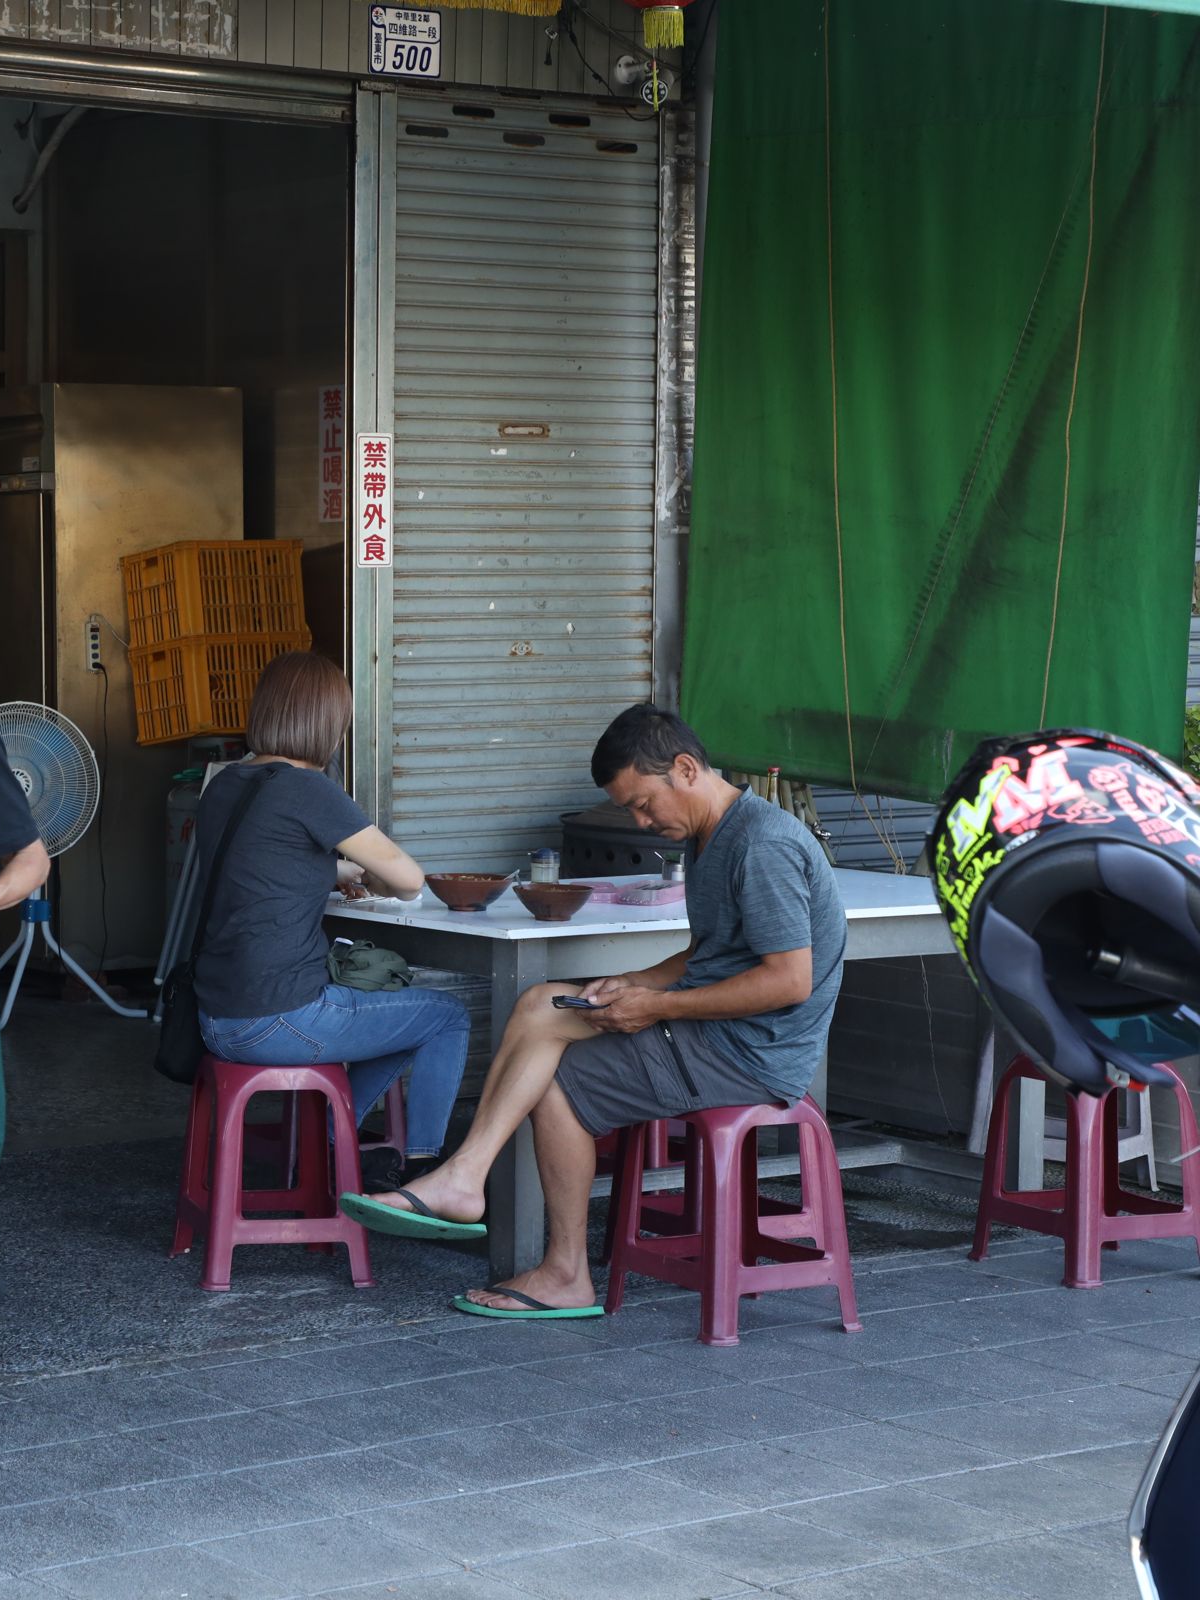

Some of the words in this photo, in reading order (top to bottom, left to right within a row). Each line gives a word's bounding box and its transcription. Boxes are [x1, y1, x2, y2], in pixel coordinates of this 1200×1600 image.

[388, 22, 437, 39] 四維路一段
[395, 11, 431, 23] 中華里2鄰
[373, 32, 383, 65] 臺東市
[391, 43, 432, 72] 500
[322, 388, 343, 520] 禁止喝酒
[363, 440, 387, 562] 禁帶外食
